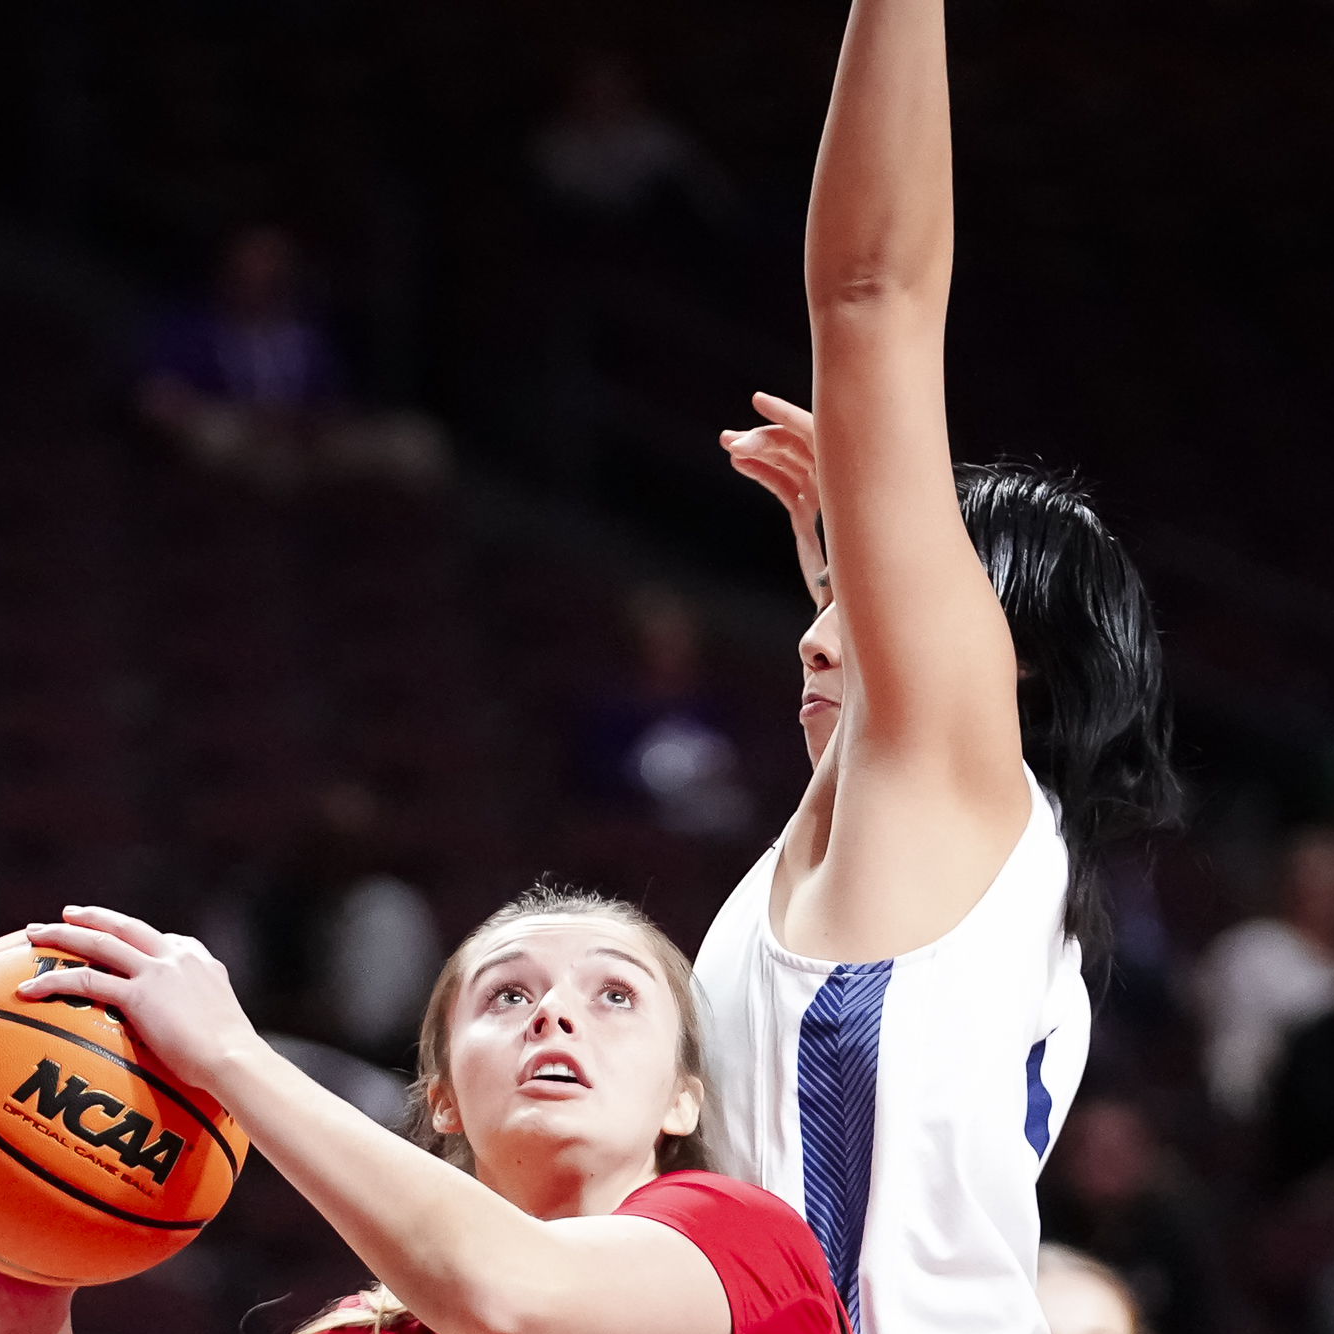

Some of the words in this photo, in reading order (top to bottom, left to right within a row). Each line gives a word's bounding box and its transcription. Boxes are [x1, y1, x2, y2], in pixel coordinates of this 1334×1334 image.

[2, 1102, 70, 1149] OFFICIAL
[73, 1146, 120, 1177] GAME
[120, 1172, 156, 1199] BALL
[11, 1057, 186, 1186] NCAA
